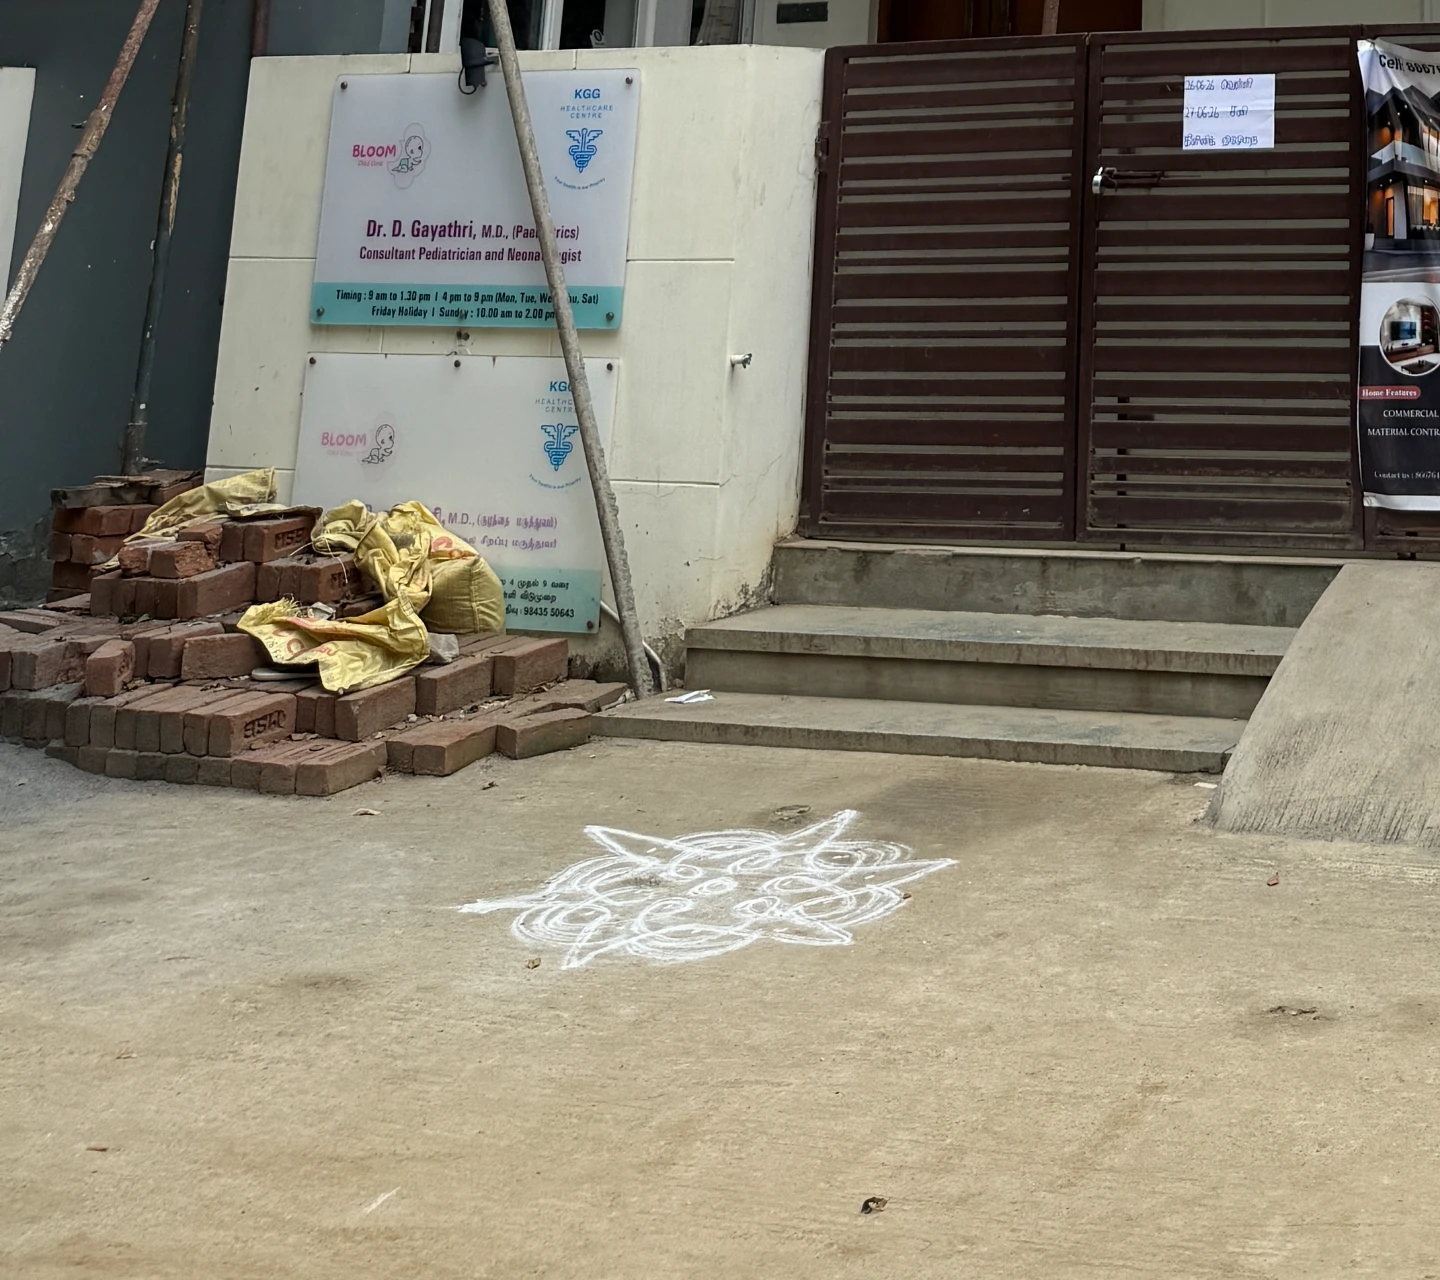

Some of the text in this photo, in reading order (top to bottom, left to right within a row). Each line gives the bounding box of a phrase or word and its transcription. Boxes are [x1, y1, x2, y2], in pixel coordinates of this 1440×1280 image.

[574, 88, 601, 100] KGG
[560, 104, 614, 112] HEALTHCARE
[352, 144, 397, 158] BLOOM
[366, 219, 580, 242] Dr. D. Gayathri, M.D., (Paerics)
[359, 246, 582, 265] Consultant Pediatrician and Neonagist
[336, 289, 362, 303] Timing
[368, 291, 374, 302] 9
[375, 292, 388, 302] am
[389, 291, 397, 302] to
[400, 291, 417, 302] 1.30
[418, 293, 431, 304] pm
[442, 292, 448, 302] 4
[449, 294, 462, 304] pm
[463, 292, 472, 302] to
[473, 292, 479, 302] 9
[481, 294, 493, 304] pm
[539, 293, 554, 304] We
[582, 293, 599, 305] Sat)
[371, 306, 396, 318] Friday
[398, 306, 427, 319] Holiday
[476, 308, 499, 318] 10.00
[500, 309, 513, 318] am
[514, 308, 523, 318] to
[524, 308, 543, 319] 2.00
[1362, 389, 1417, 397] Home Features
[535, 397, 573, 405] HEALTHC
[1383, 409, 1439, 418] COMMERCIAL
[1367, 428, 1409, 437] MATERIAL
[321, 431, 367, 447] BLOOM
[448, 511, 475, 527] M.D.,
[509, 578, 514, 586] 4
[517, 578, 540, 589] முதல்
[542, 579, 548, 587] 9
